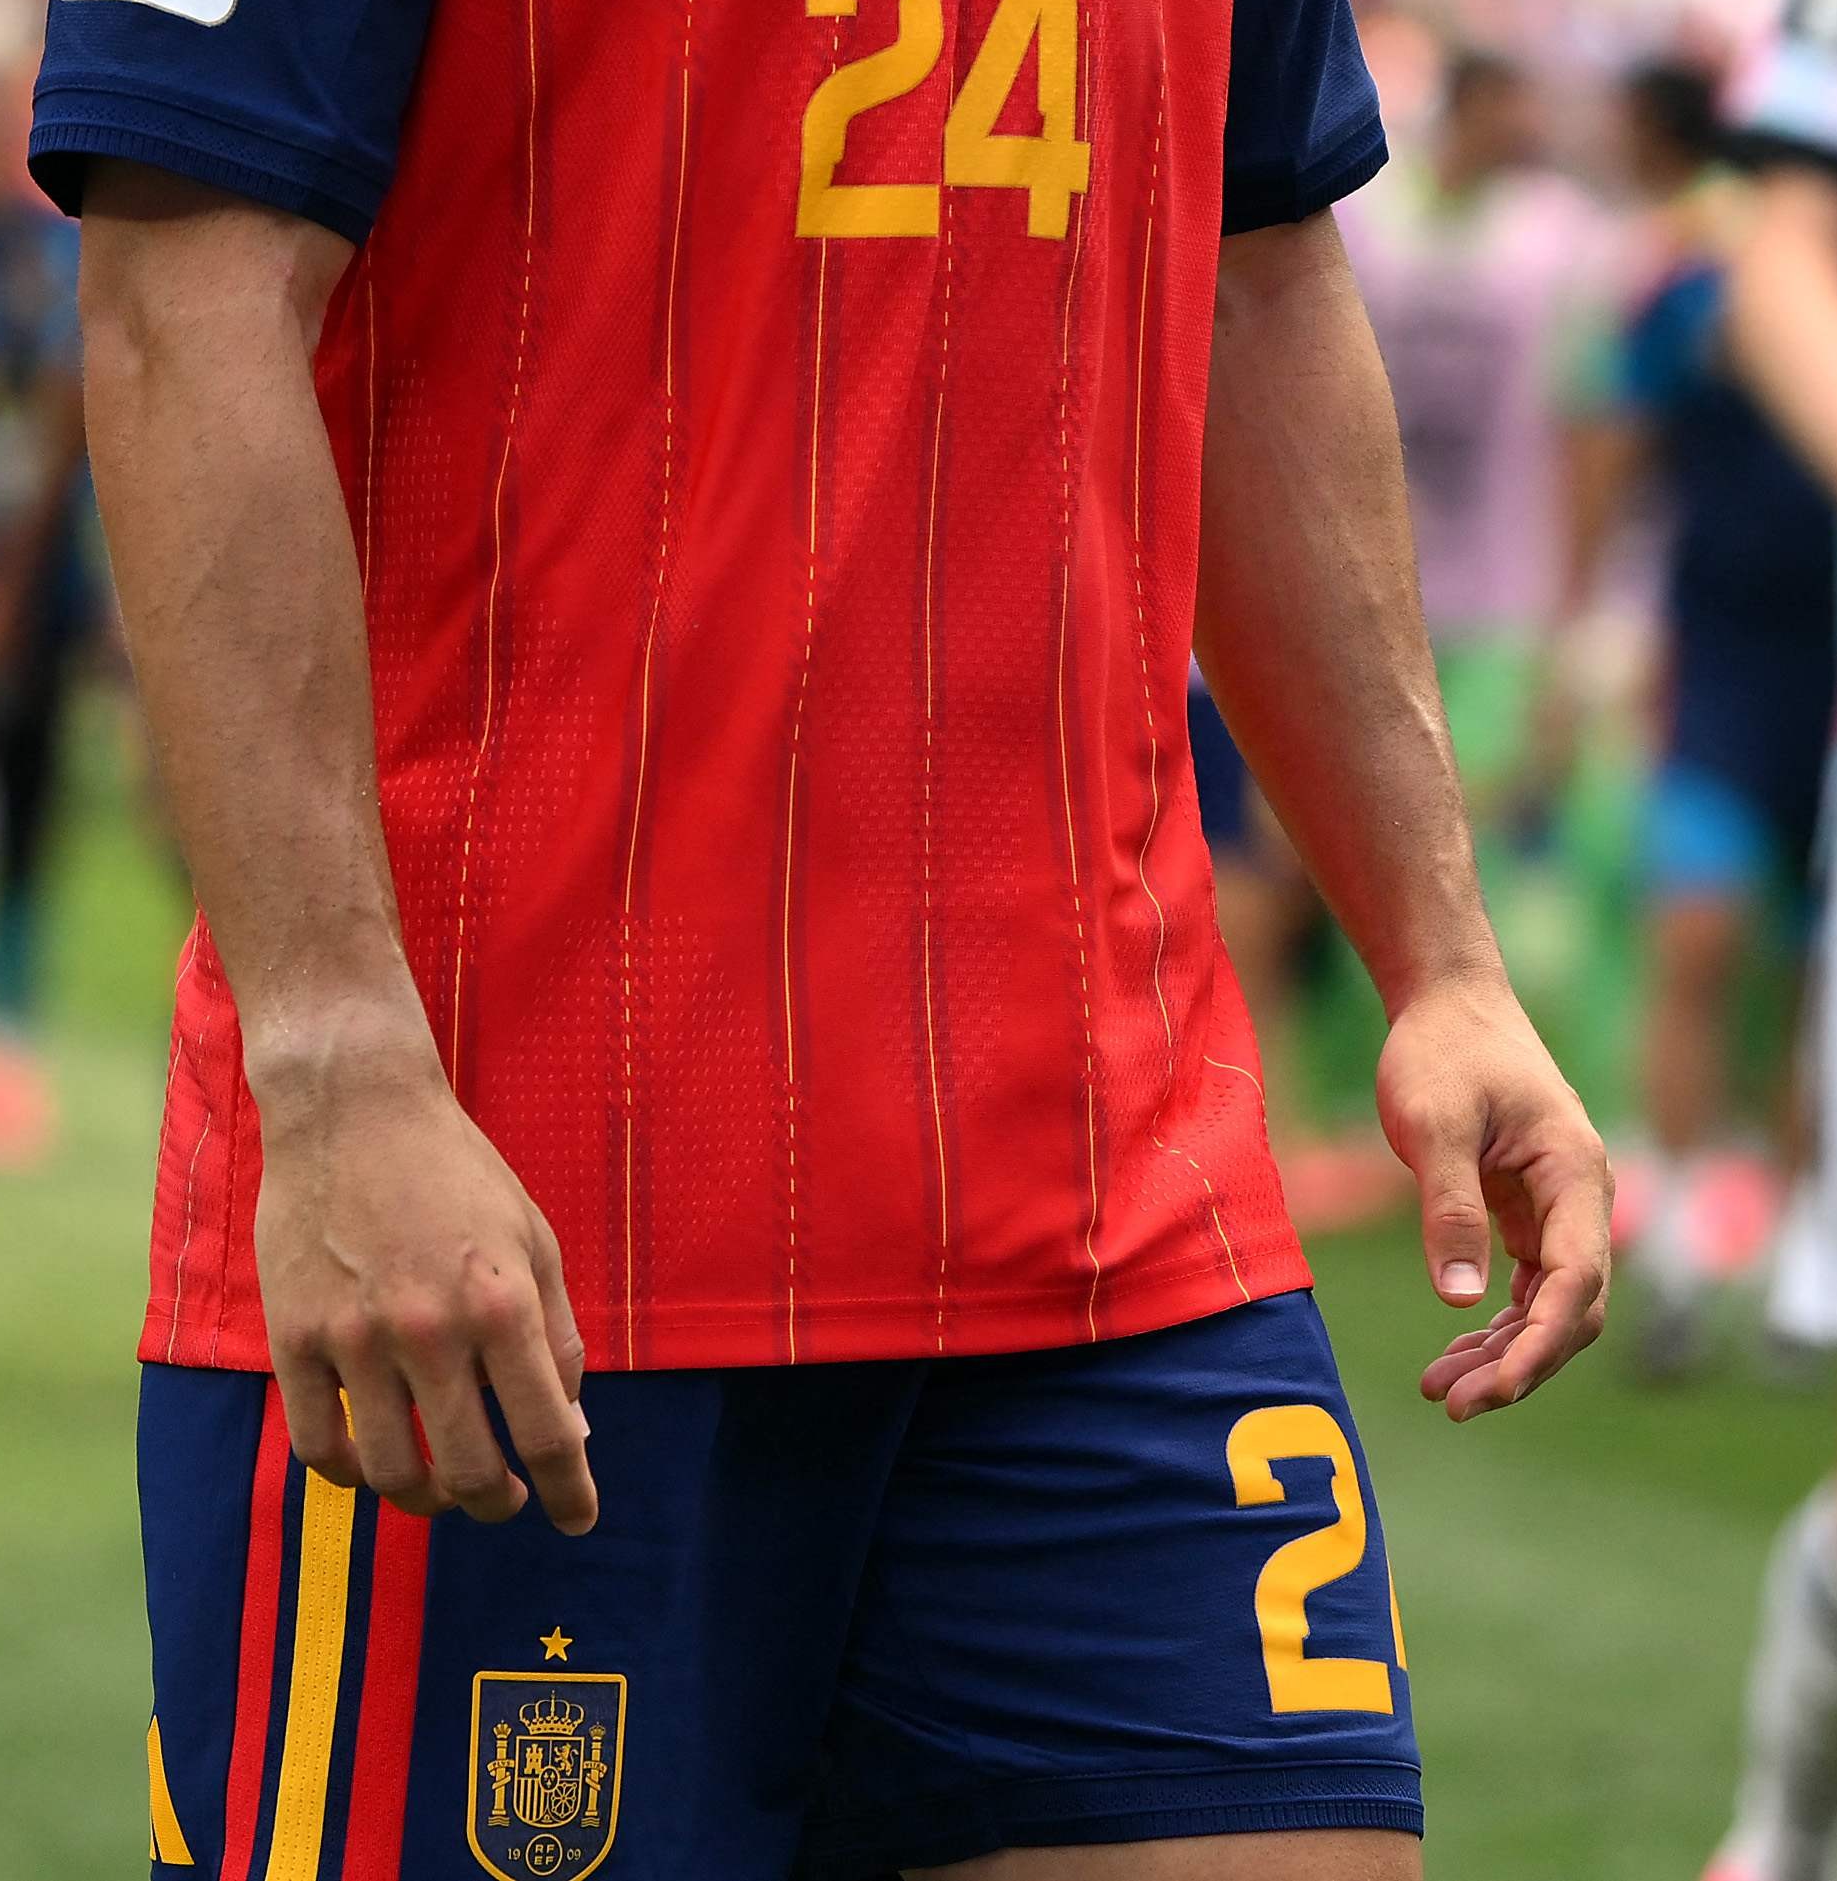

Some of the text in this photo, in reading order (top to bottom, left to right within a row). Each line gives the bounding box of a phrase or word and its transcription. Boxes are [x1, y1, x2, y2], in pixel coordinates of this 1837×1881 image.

[1225, 1403, 1408, 1716] 2
[535, 1844, 555, 1853] RF
[507, 1848, 582, 1861] 19 09
[534, 1855, 554, 1865] EF
